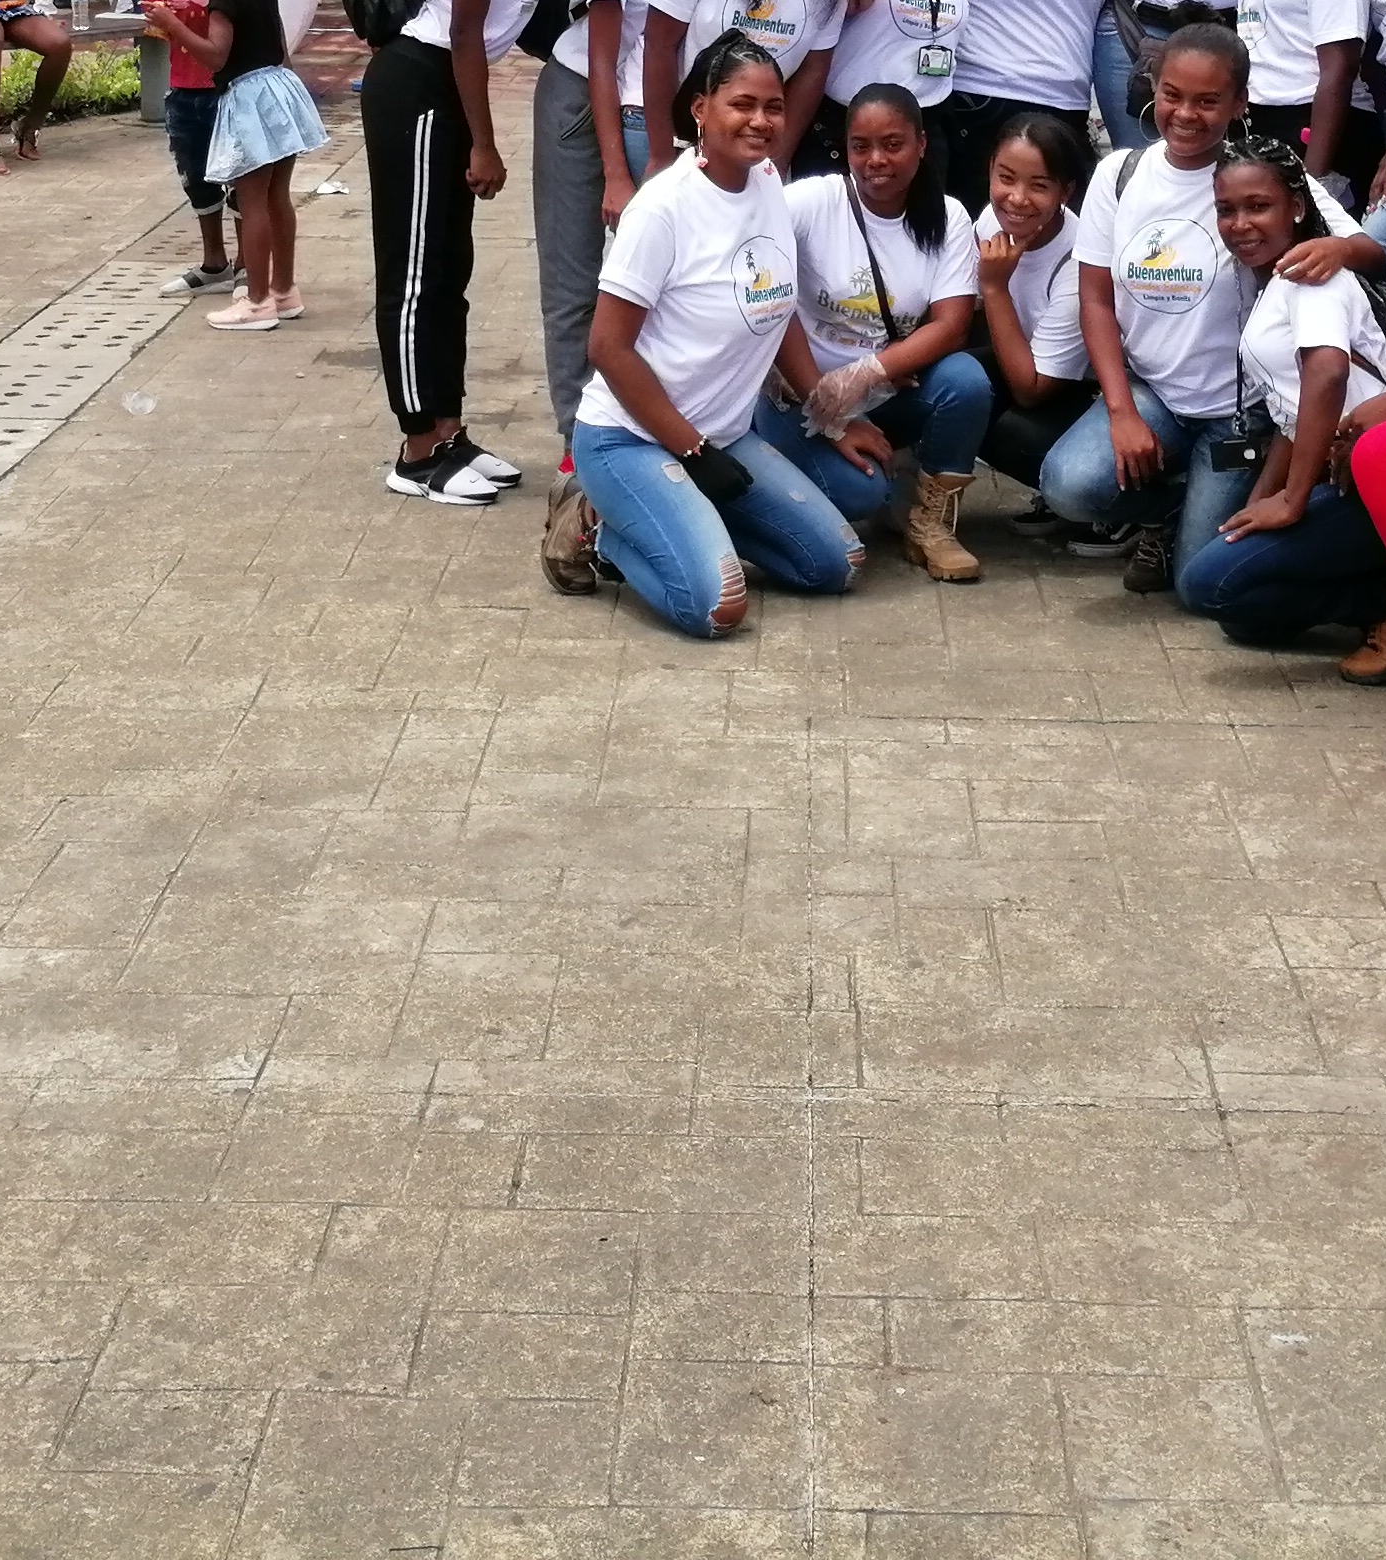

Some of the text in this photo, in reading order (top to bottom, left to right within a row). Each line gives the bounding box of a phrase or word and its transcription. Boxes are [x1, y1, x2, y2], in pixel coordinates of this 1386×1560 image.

[731, 10, 796, 36] Buenaventura
[1127, 261, 1204, 282] Buenaventura
[744, 281, 794, 304] Buenaventura
